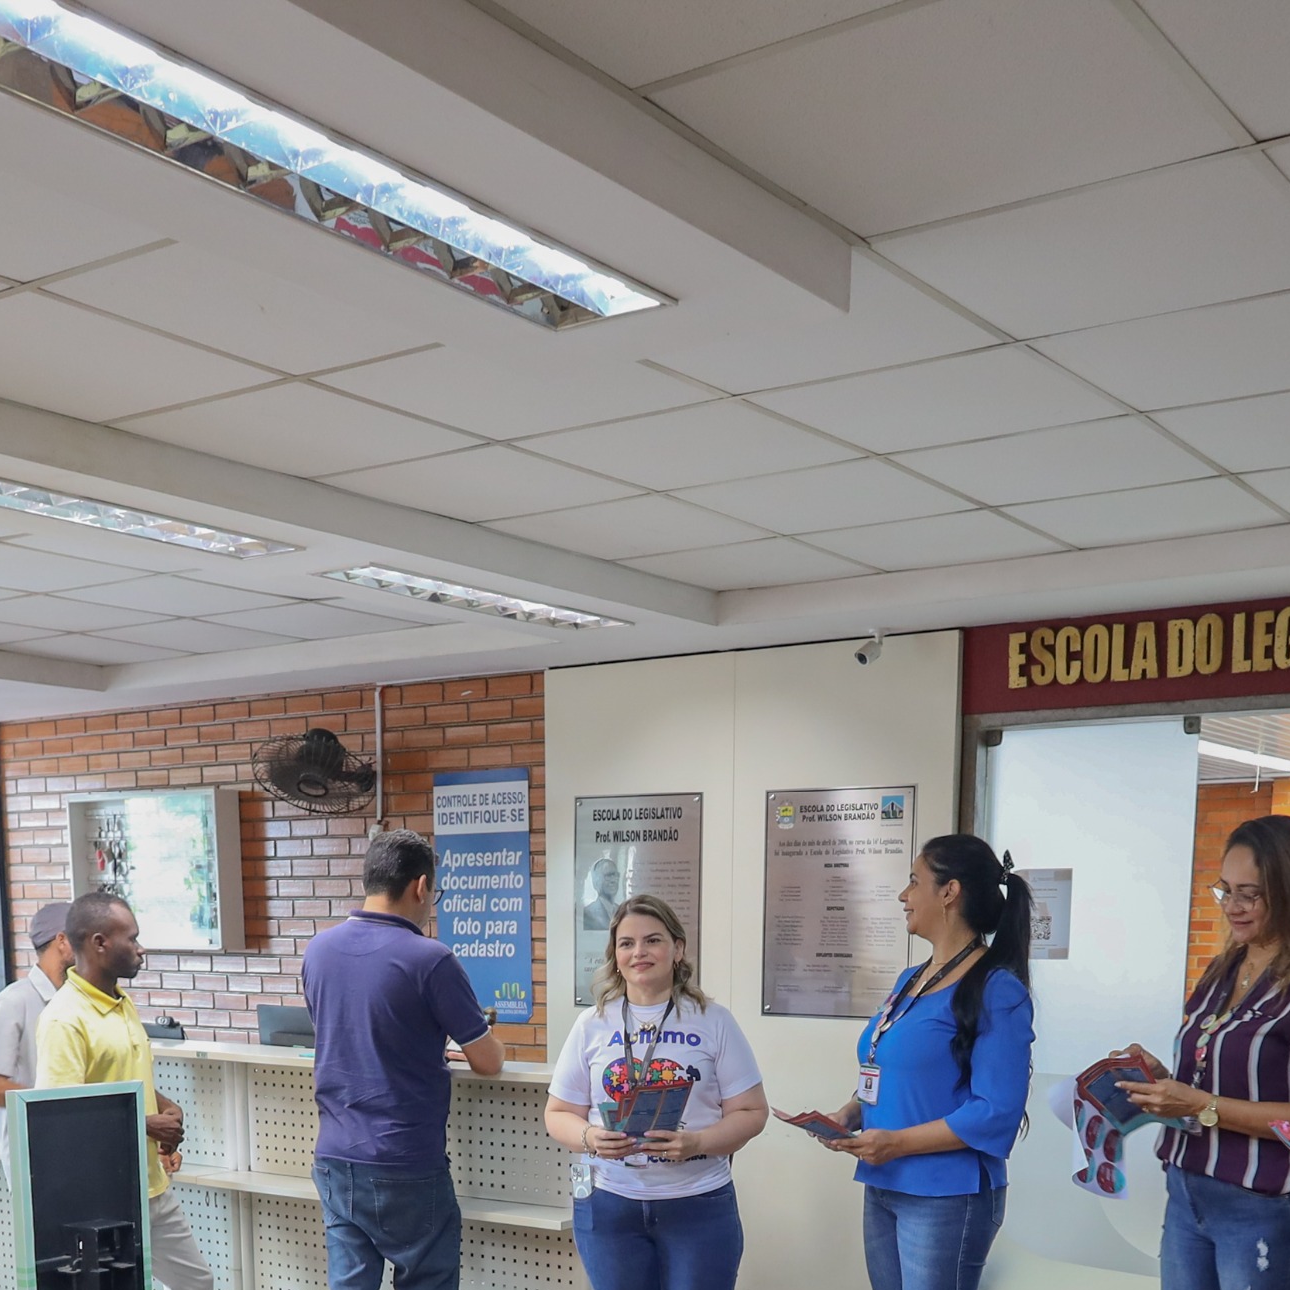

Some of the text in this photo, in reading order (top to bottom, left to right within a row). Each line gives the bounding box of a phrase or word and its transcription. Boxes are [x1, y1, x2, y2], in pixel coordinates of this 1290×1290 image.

[1008, 620, 1159, 690] ESCOLA
[1166, 612, 1224, 680] DO
[436, 791, 526, 808] CONTROLE DE ACESSO:
[799, 802, 879, 813] ESCOLA DO LEGISLATIVO
[437, 808, 525, 826] IDENTIFIQUE-SE
[593, 807, 683, 821] ESCOLA DO LEGISLATIVO
[802, 812, 875, 823] Prof. WILSON BRANDÃO
[595, 826, 679, 843] Prof. WILSON BRANDÃO
[441, 848, 523, 872] Apresentar
[441, 871, 524, 890] documento
[443, 893, 523, 913] oficial com
[453, 916, 518, 940] foto para
[452, 939, 516, 957] cadastro
